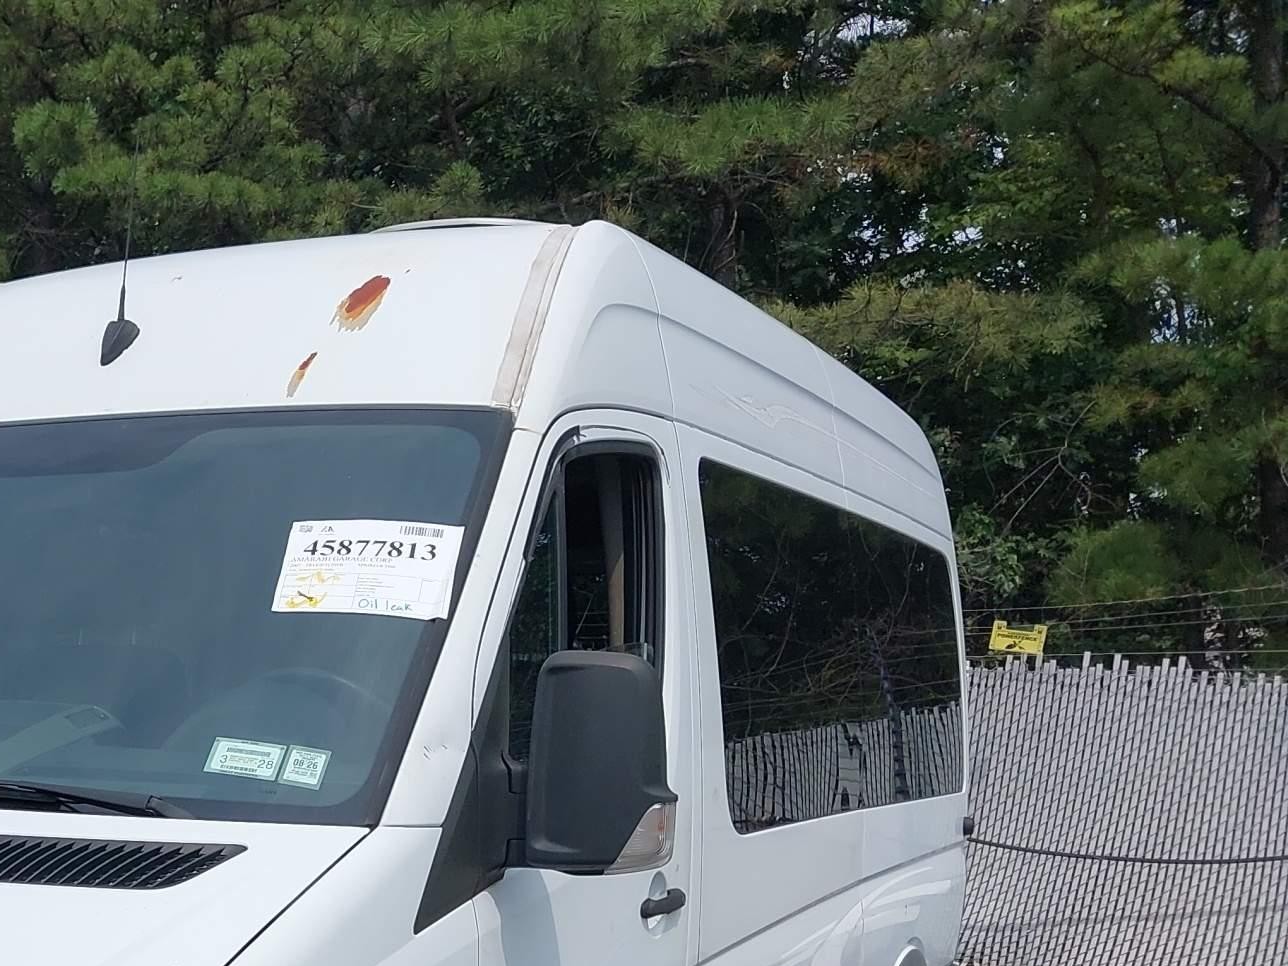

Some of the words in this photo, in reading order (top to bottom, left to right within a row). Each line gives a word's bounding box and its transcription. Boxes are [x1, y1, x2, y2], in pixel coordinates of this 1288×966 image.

[303, 539, 437, 561] 45877813
[358, 598, 378, 609] Oil
[385, 599, 413, 611] leak
[219, 754, 228, 764] 3
[257, 759, 274, 770] 28
[293, 758, 305, 767] 08
[306, 760, 319, 770] 26
